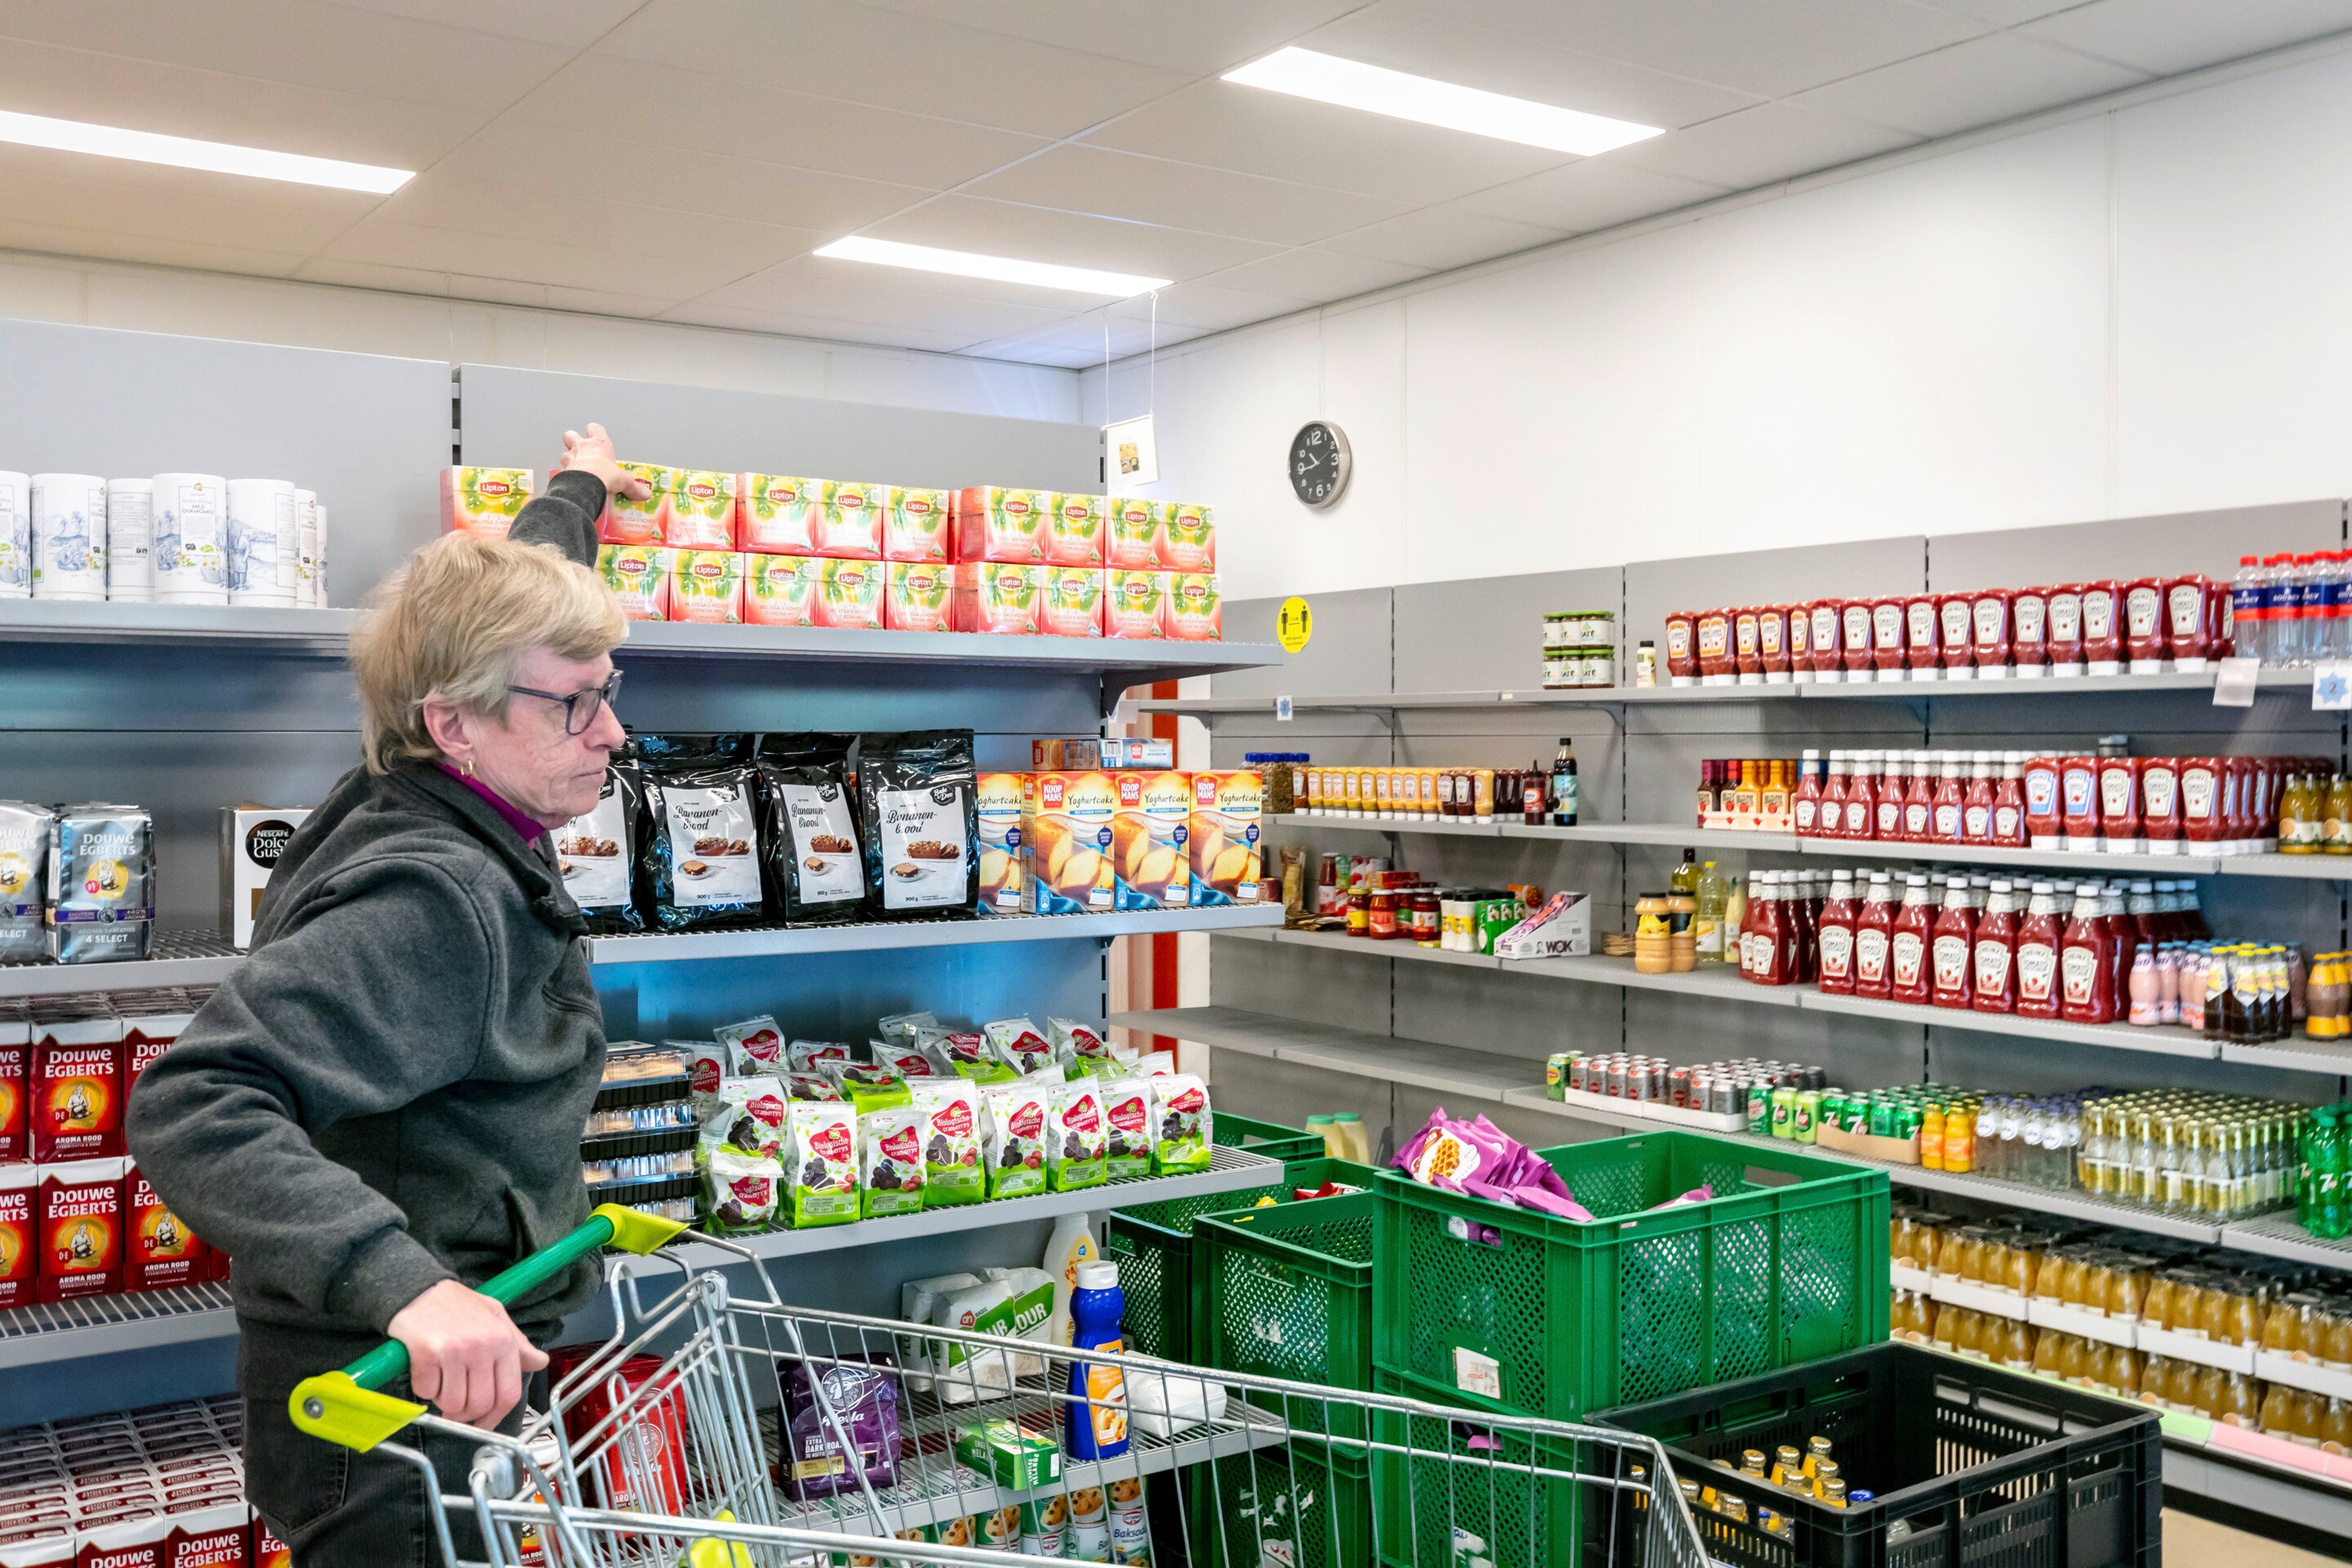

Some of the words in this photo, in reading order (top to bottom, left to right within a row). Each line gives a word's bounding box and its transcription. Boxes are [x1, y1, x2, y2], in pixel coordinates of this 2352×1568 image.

[1312, 431, 1321, 445] 12
[1330, 441, 1335, 449] 2
[1298, 449, 1305, 457] 10
[1331, 453, 1339, 466] 3
[1298, 462, 1305, 474] 9
[482, 483, 507, 492] Lipton
[690, 486, 714, 496] Lipton
[1316, 484, 1323, 497] 6
[771, 492, 794, 500] Lipton
[1308, 488, 1312, 498] 7
[840, 497, 862, 506] Lipton
[907, 502, 929, 510] Lipton
[1007, 503, 1027, 511] Lipton
[1067, 508, 1086, 516] Lipton
[1127, 513, 1146, 522] Lipton
[1181, 517, 1199, 526] Lipton
[620, 562, 645, 571] Lipton
[697, 566, 720, 575] Lipton
[771, 572, 794, 580] Lipton
[841, 575, 862, 583] Lipton
[1128, 585, 1147, 594] Lipton
[1186, 587, 1204, 596] Lipton
[2329, 683, 2337, 693] 2
[1044, 784, 1062, 794] KOOP
[1121, 783, 1139, 791] KOOP
[1197, 782, 1214, 791] KOOP
[1044, 792, 1062, 802] MANS
[1121, 791, 1139, 800] MANS
[1197, 791, 1214, 799] MANS
[1219, 793, 1261, 805] Yoghurtcake
[1068, 795, 1114, 808] Yoghurtcake
[1144, 794, 1188, 806] Yoghurtcake
[791, 804, 826, 817] Bananen-
[257, 828, 289, 837] NESCAFÉ
[79, 846, 136, 856] EGBERTS
[0, 929, 27, 938] ELECT
[96, 934, 128, 942] SELECT
[1546, 940, 1573, 953] WOK
[45, 1062, 114, 1078] EGBERTS
[1111, 1112, 1143, 1122] Biologische
[83, 1134, 102, 1143] ROOD
[48, 1200, 117, 1218] EGBERTS
[145, 1263, 170, 1272] AROMA
[171, 1260, 189, 1269] ROOD
[59, 1276, 85, 1284] AROMA
[87, 1273, 106, 1281] ROOD
[975, 1307, 988, 1317] BASIC
[174, 1547, 243, 1568] EGBERTS
